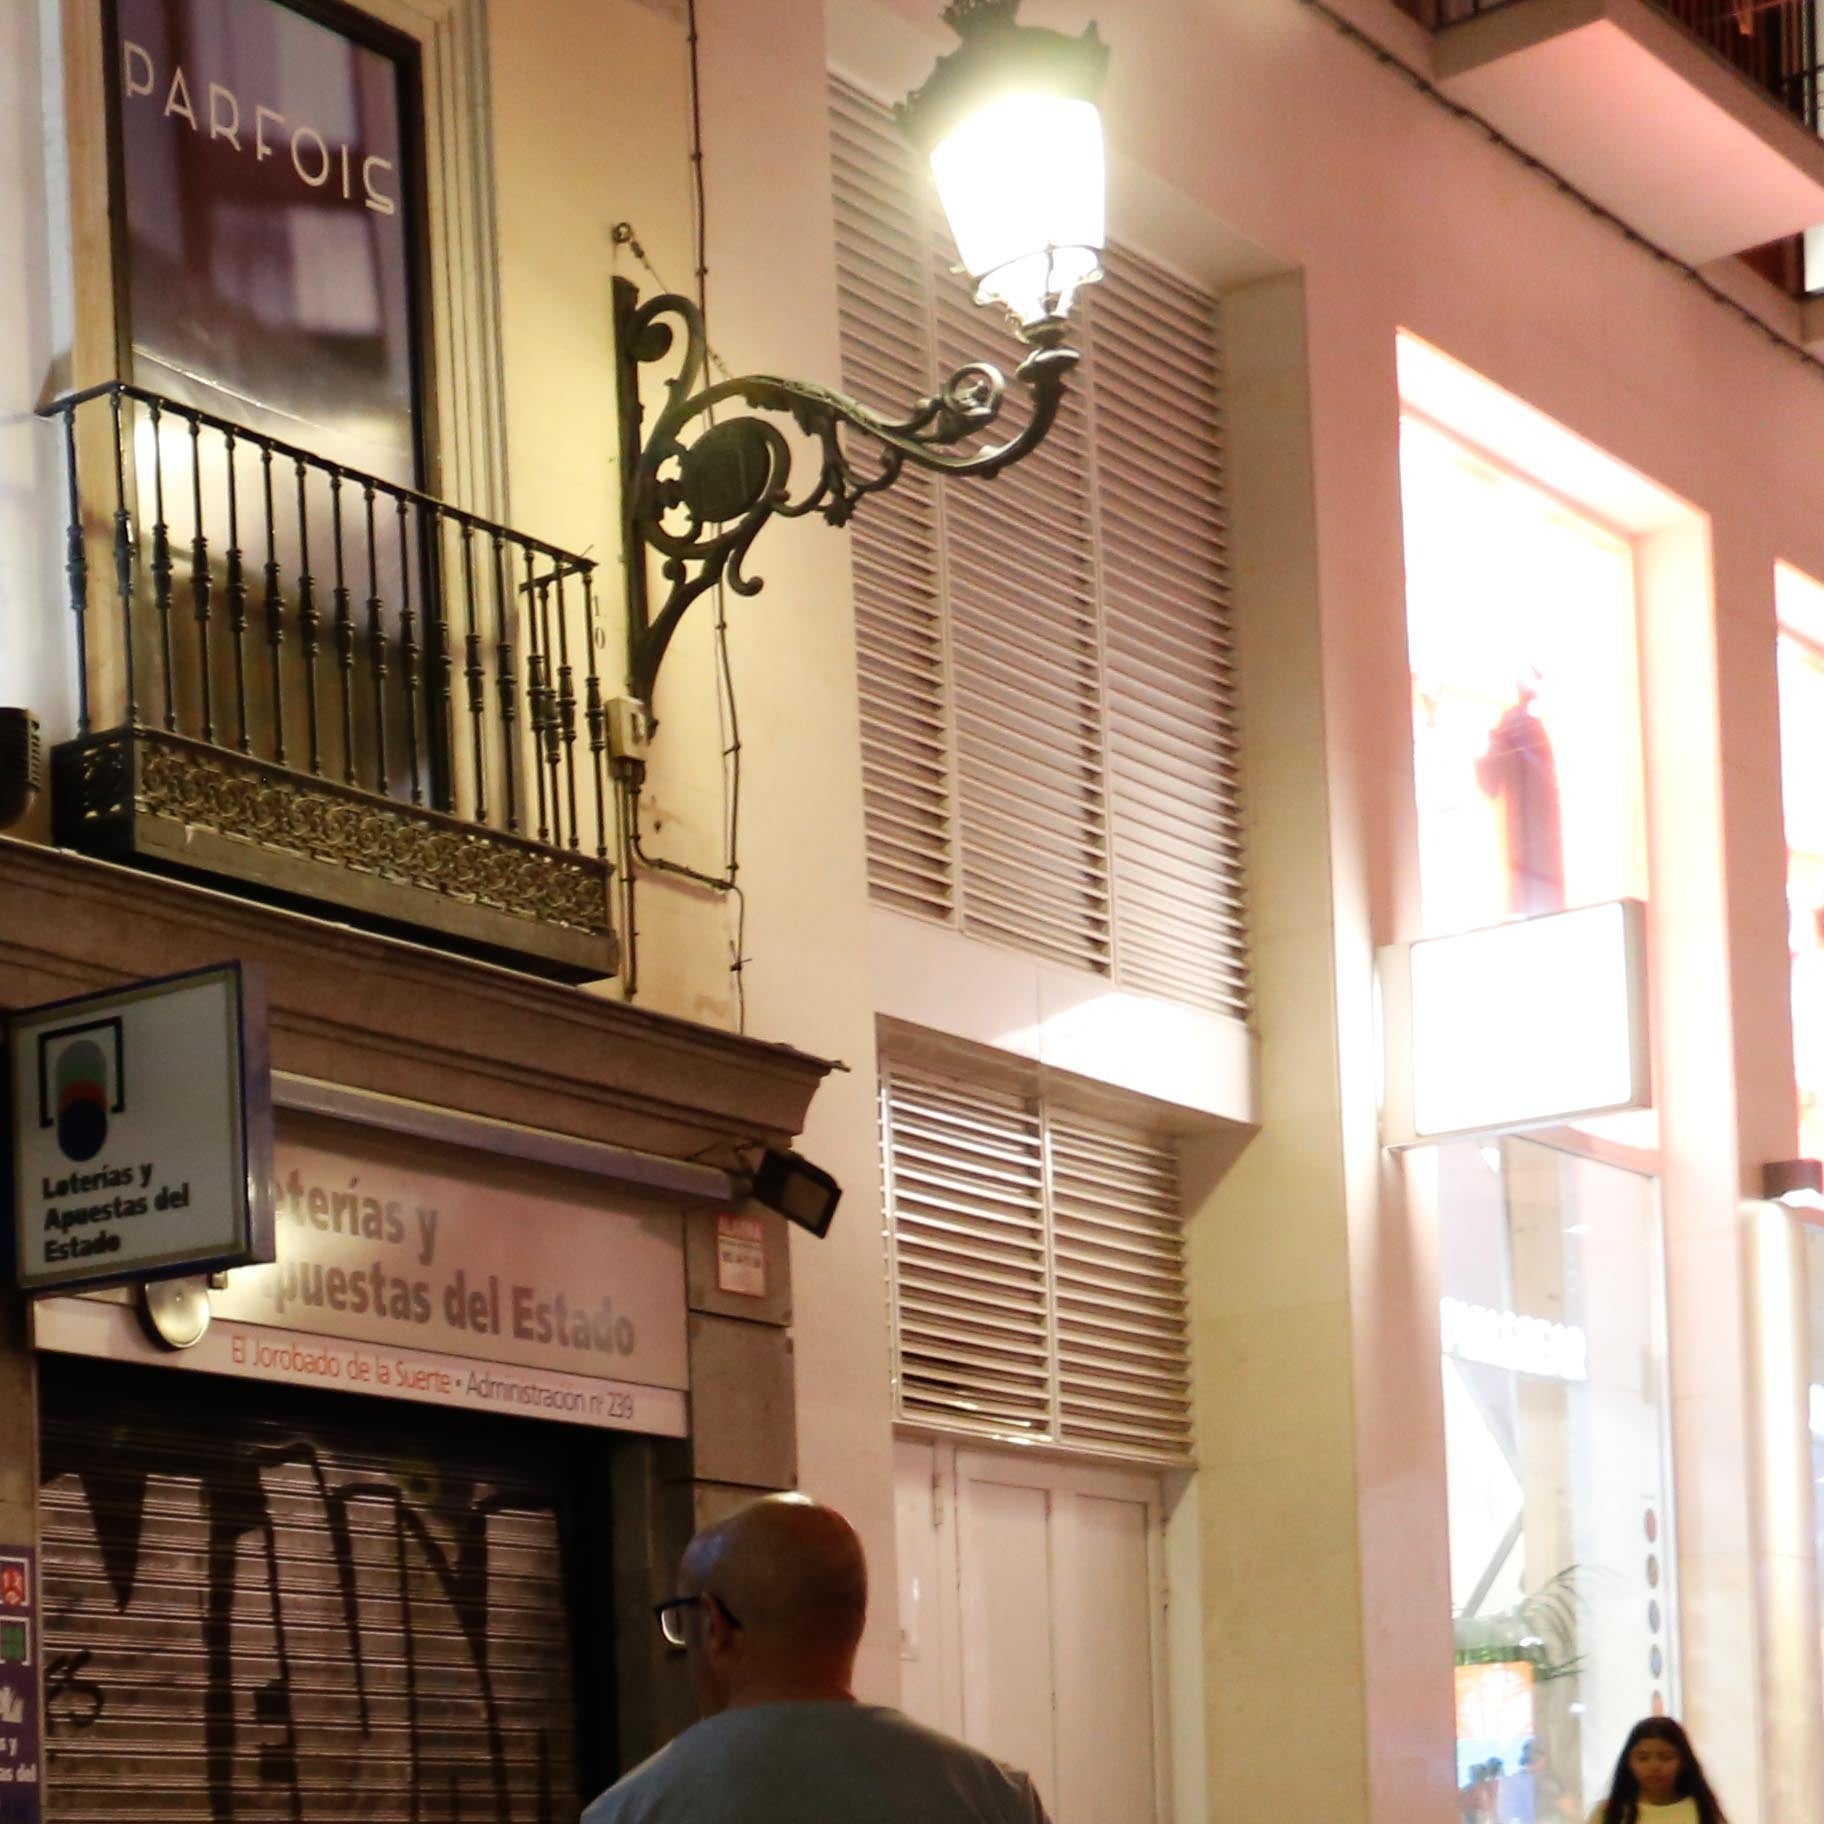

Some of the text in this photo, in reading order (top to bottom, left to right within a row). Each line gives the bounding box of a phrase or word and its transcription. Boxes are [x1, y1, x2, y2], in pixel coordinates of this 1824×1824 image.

[123, 39, 395, 215] PARFOIS
[42, 1163, 153, 1199] Loterías y
[44, 1182, 191, 1234] Apuestas del
[44, 1230, 122, 1262] Estado
[416, 1205, 438, 1266] y
[444, 1269, 499, 1335] del
[512, 1286, 635, 1356] Estado
[232, 1335, 245, 1363] El
[253, 1338, 340, 1377] Jorobado
[347, 1349, 370, 1382] de
[375, 1355, 390, 1384] la
[395, 1360, 451, 1394] Suerte
